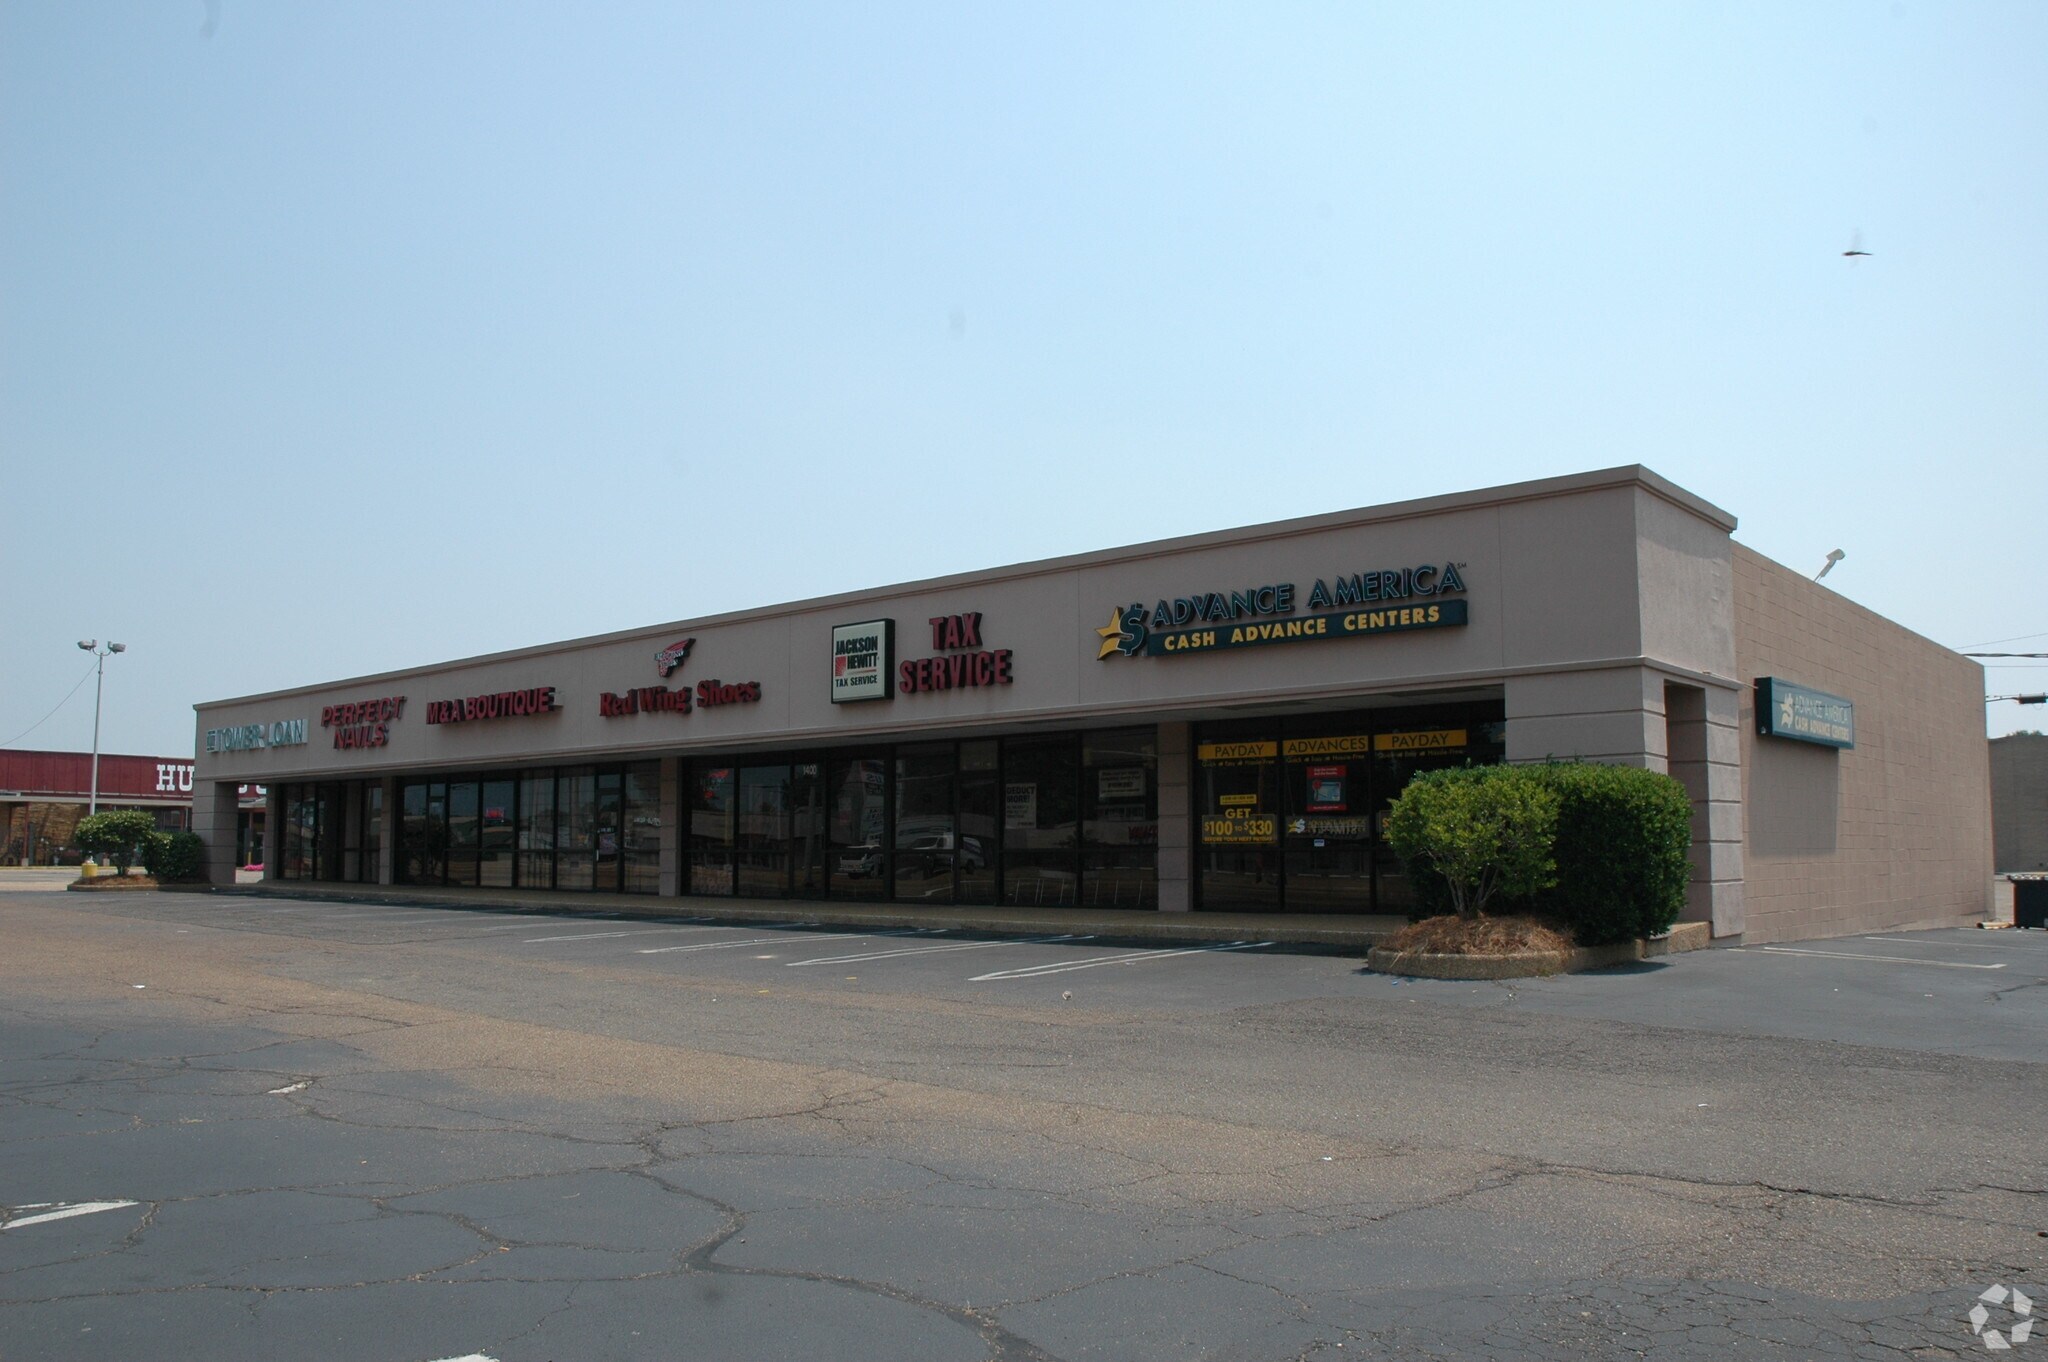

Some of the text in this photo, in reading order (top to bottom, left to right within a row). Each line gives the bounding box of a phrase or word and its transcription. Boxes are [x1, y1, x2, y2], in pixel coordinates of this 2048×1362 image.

[1150, 582, 1295, 628] ADVANCE
[1307, 562, 1466, 609] AMERICA
[929, 612, 982, 650] TAX
[1164, 605, 1440, 651] CASH ADVANCE CENTERS
[835, 635, 878, 655] JACKSON
[847, 652, 878, 669] HEWITT
[900, 649, 1013, 694] SERVICE
[835, 675, 878, 687] TAX SERVICE
[321, 696, 407, 727] PERFECT
[426, 686, 556, 725] M&A BOUTIQUE
[599, 678, 761, 717] Red Wing Shoes
[216, 719, 309, 750] TOWER LOAN
[333, 722, 389, 750] NAILS
[1288, 737, 1366, 753] ADVANCES
[1392, 733, 1449, 748] PAYDAY
[1214, 744, 1264, 757] PAYDAY
[1204, 820, 1233, 835] $100
[1243, 820, 1272, 835] $330
[1225, 808, 1252, 819] GET
